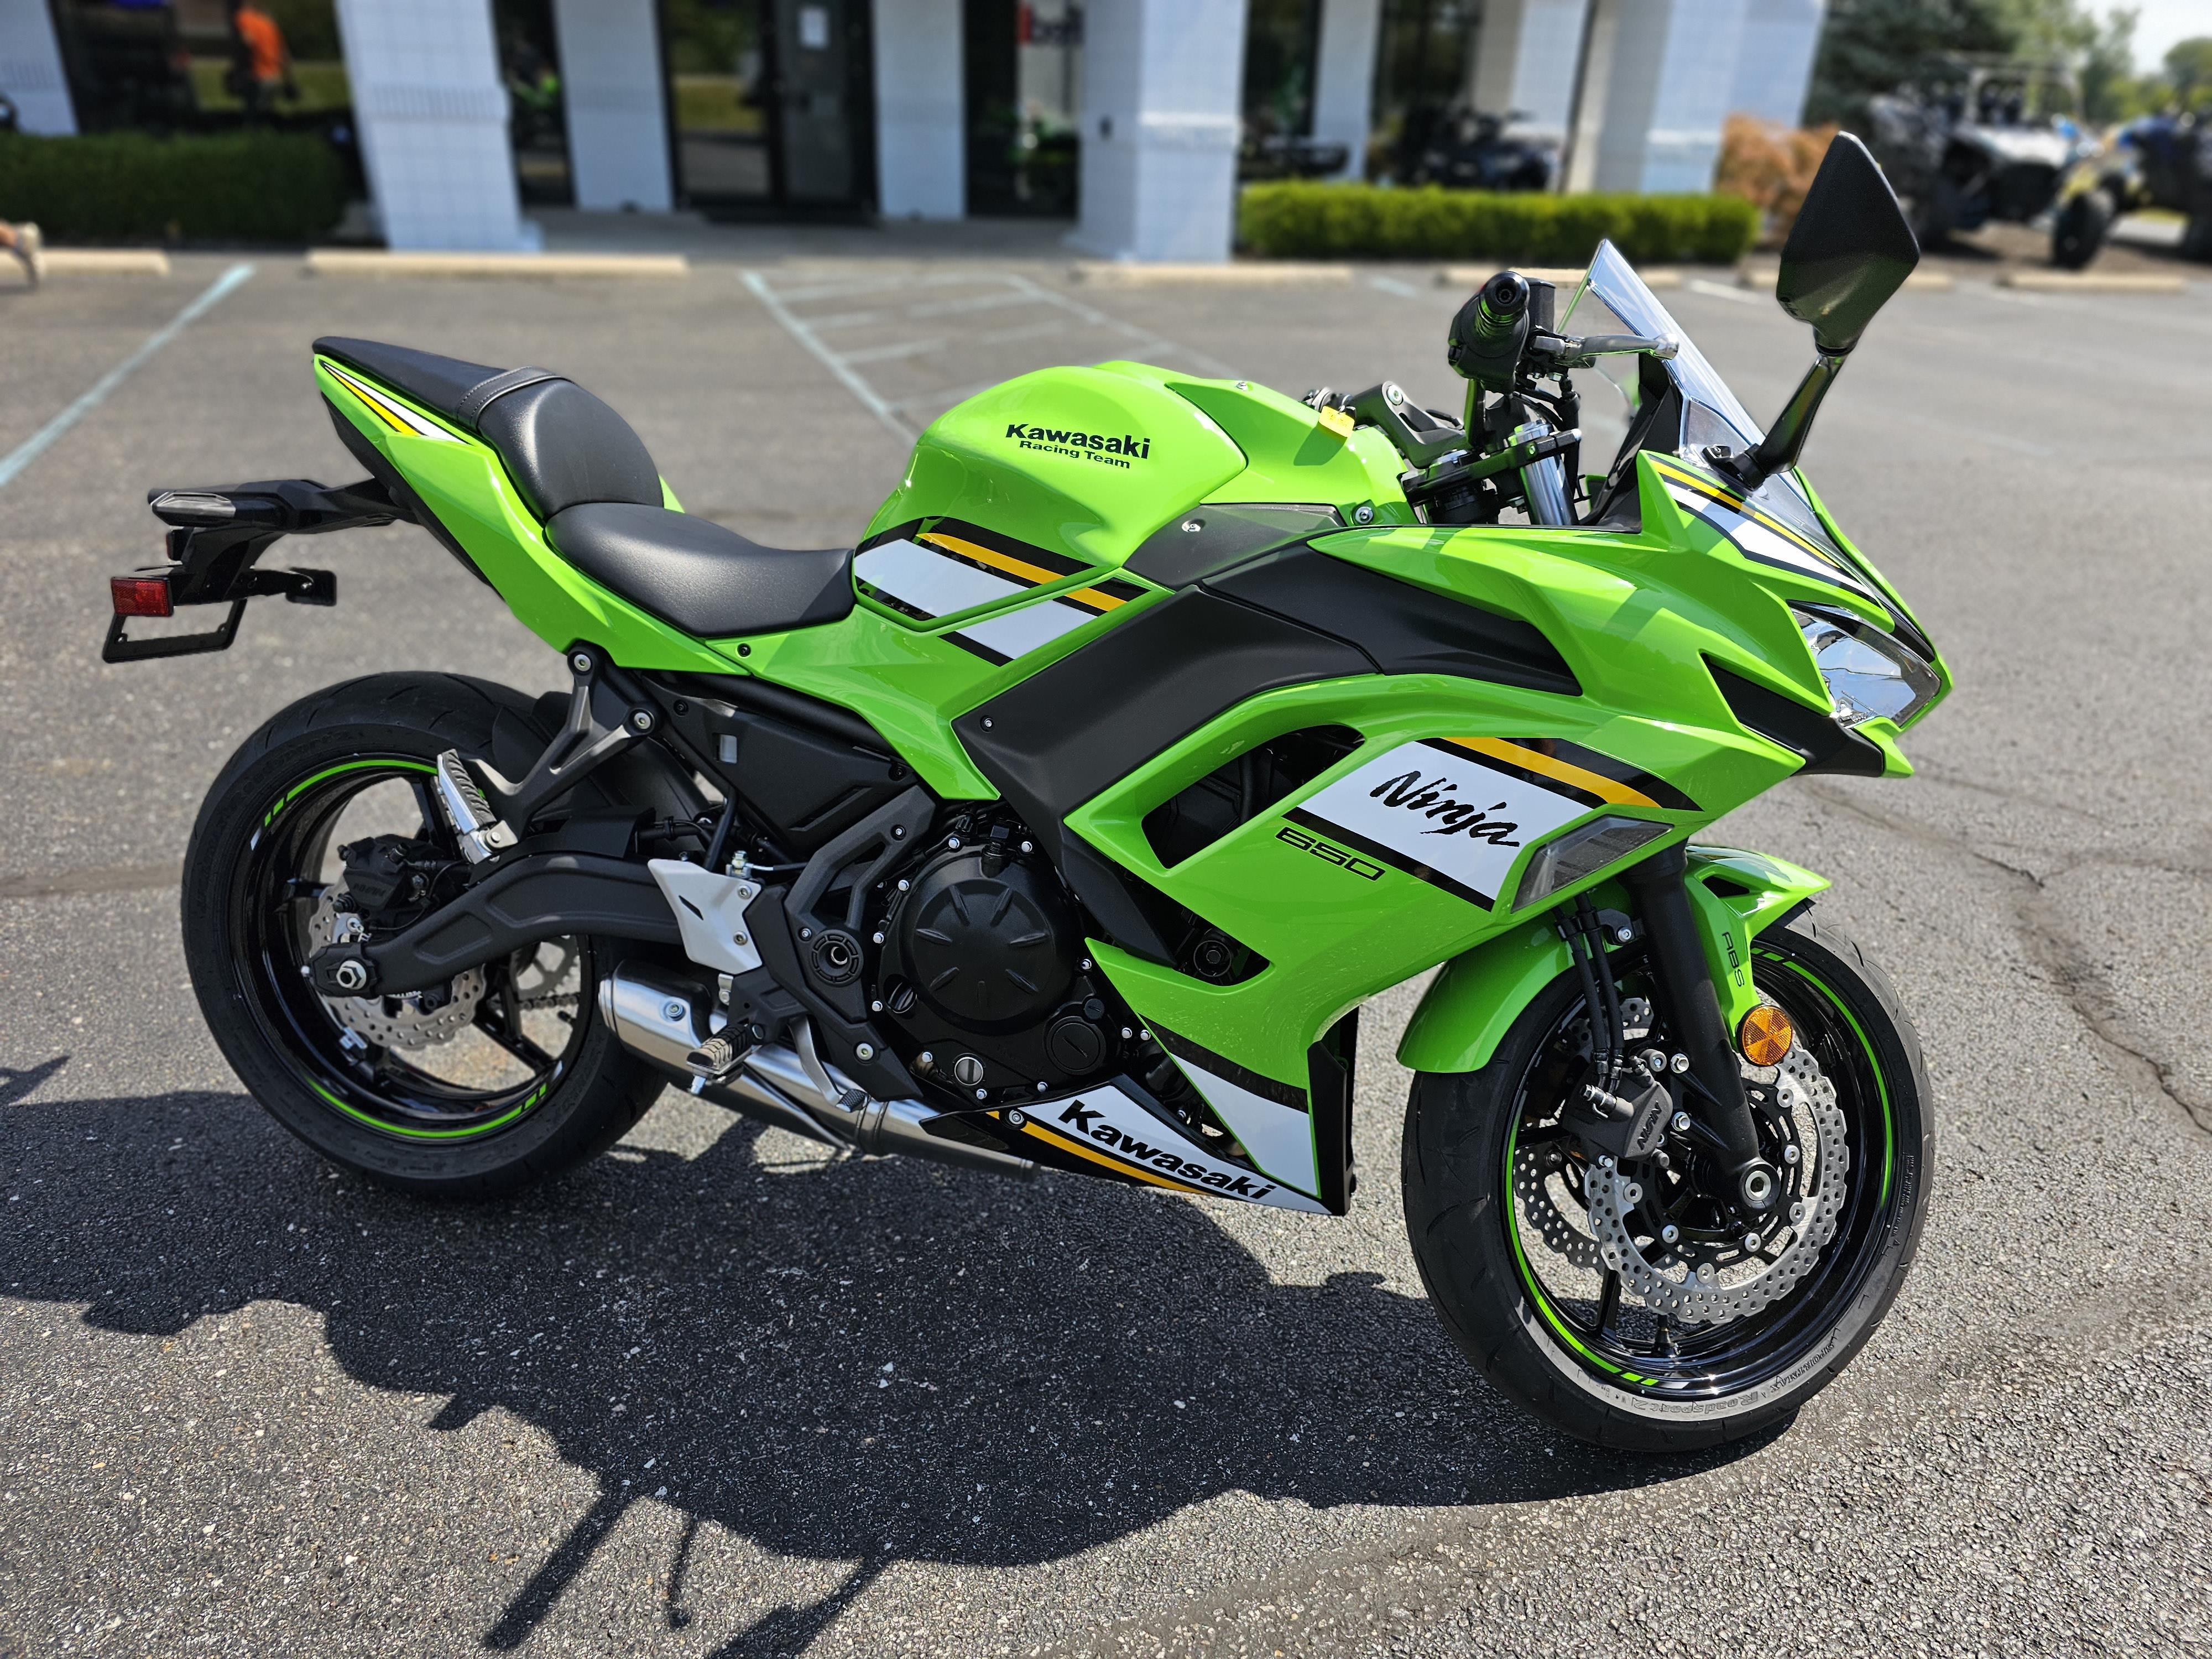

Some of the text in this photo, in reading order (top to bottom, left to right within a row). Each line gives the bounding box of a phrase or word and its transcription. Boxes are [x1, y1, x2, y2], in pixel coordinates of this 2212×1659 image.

[1005, 424, 1150, 459] Kawasaki
[1019, 441, 1130, 469] Racing Team
[1370, 770, 1520, 847] Ninja
[1275, 827, 1385, 881] 650
[1722, 932, 1744, 987] ABS
[1058, 1099, 1276, 1199] Kawasaki
